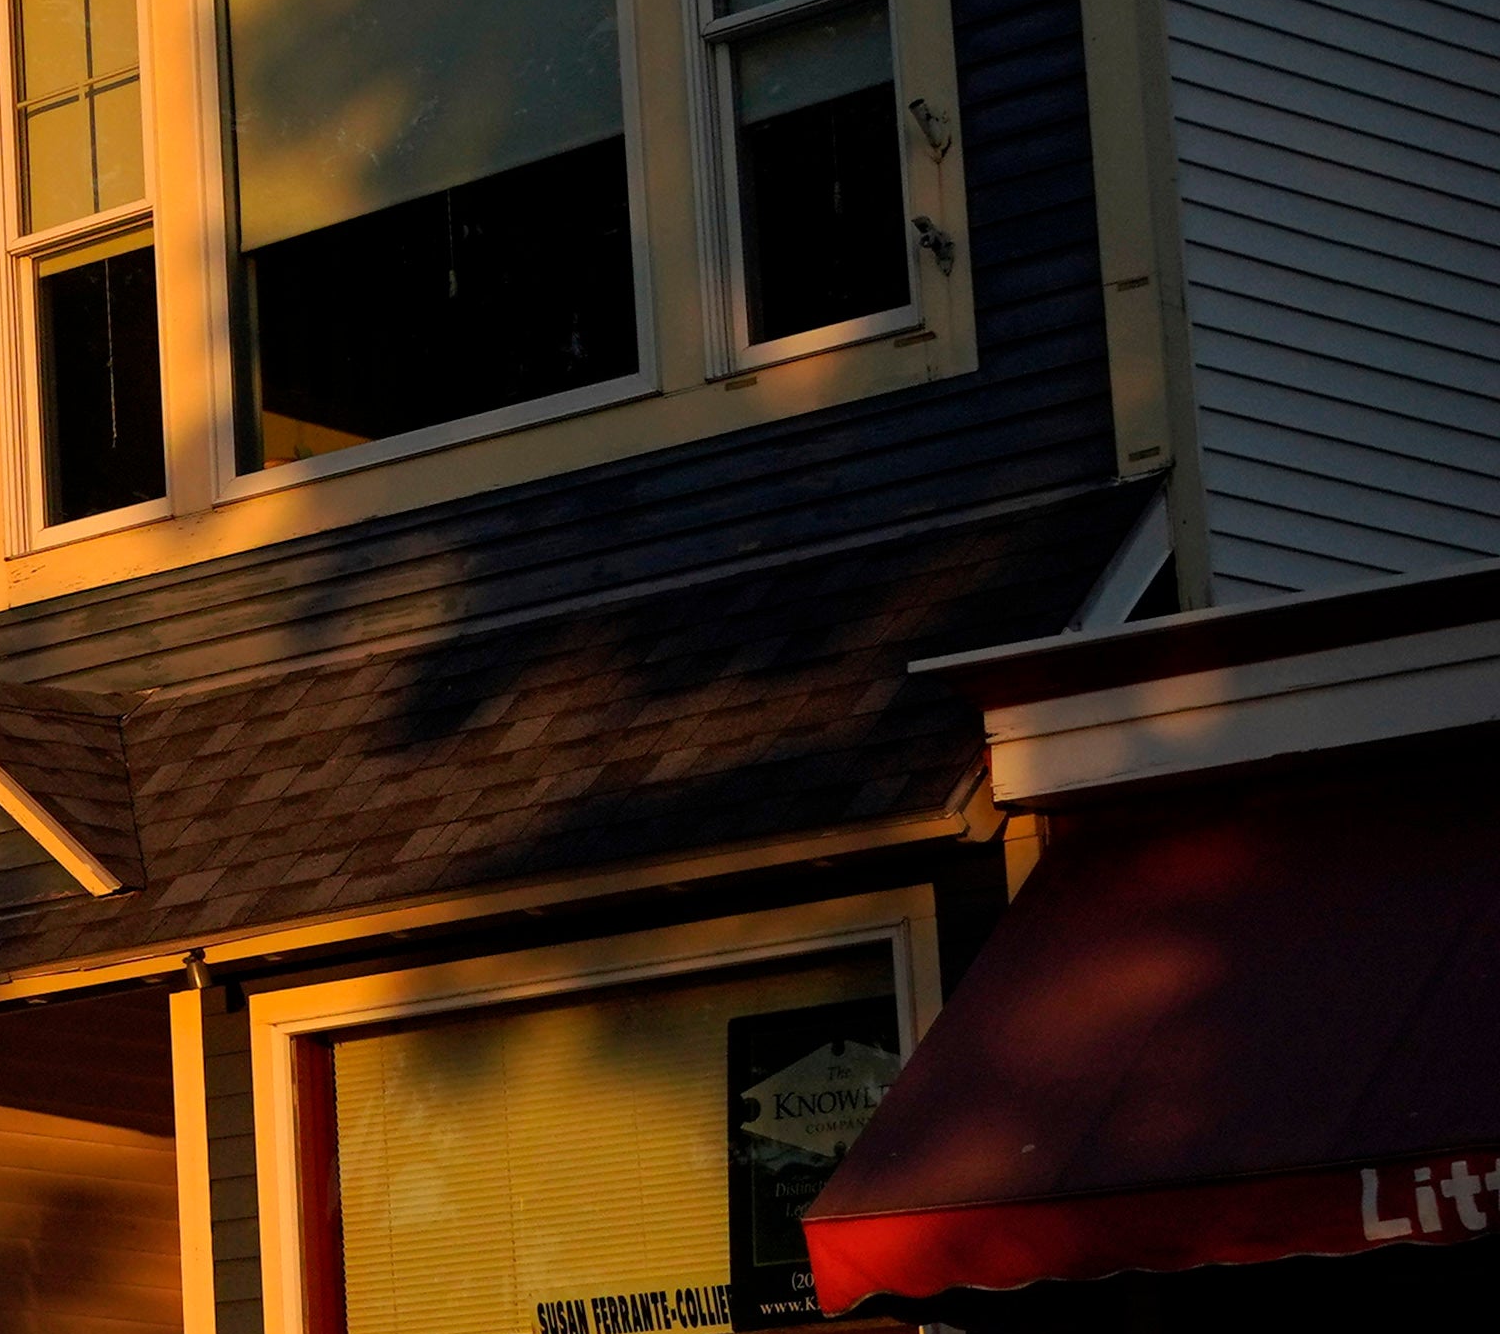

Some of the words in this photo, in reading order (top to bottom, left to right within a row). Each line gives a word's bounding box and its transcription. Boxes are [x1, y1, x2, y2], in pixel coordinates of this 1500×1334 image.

[828, 1066, 851, 1080] The
[805, 1117, 870, 1136] COMPAN
[774, 1179, 828, 1198] Distinct
[791, 1272, 815, 1292] (20
[759, 1296, 820, 1316] www.K
